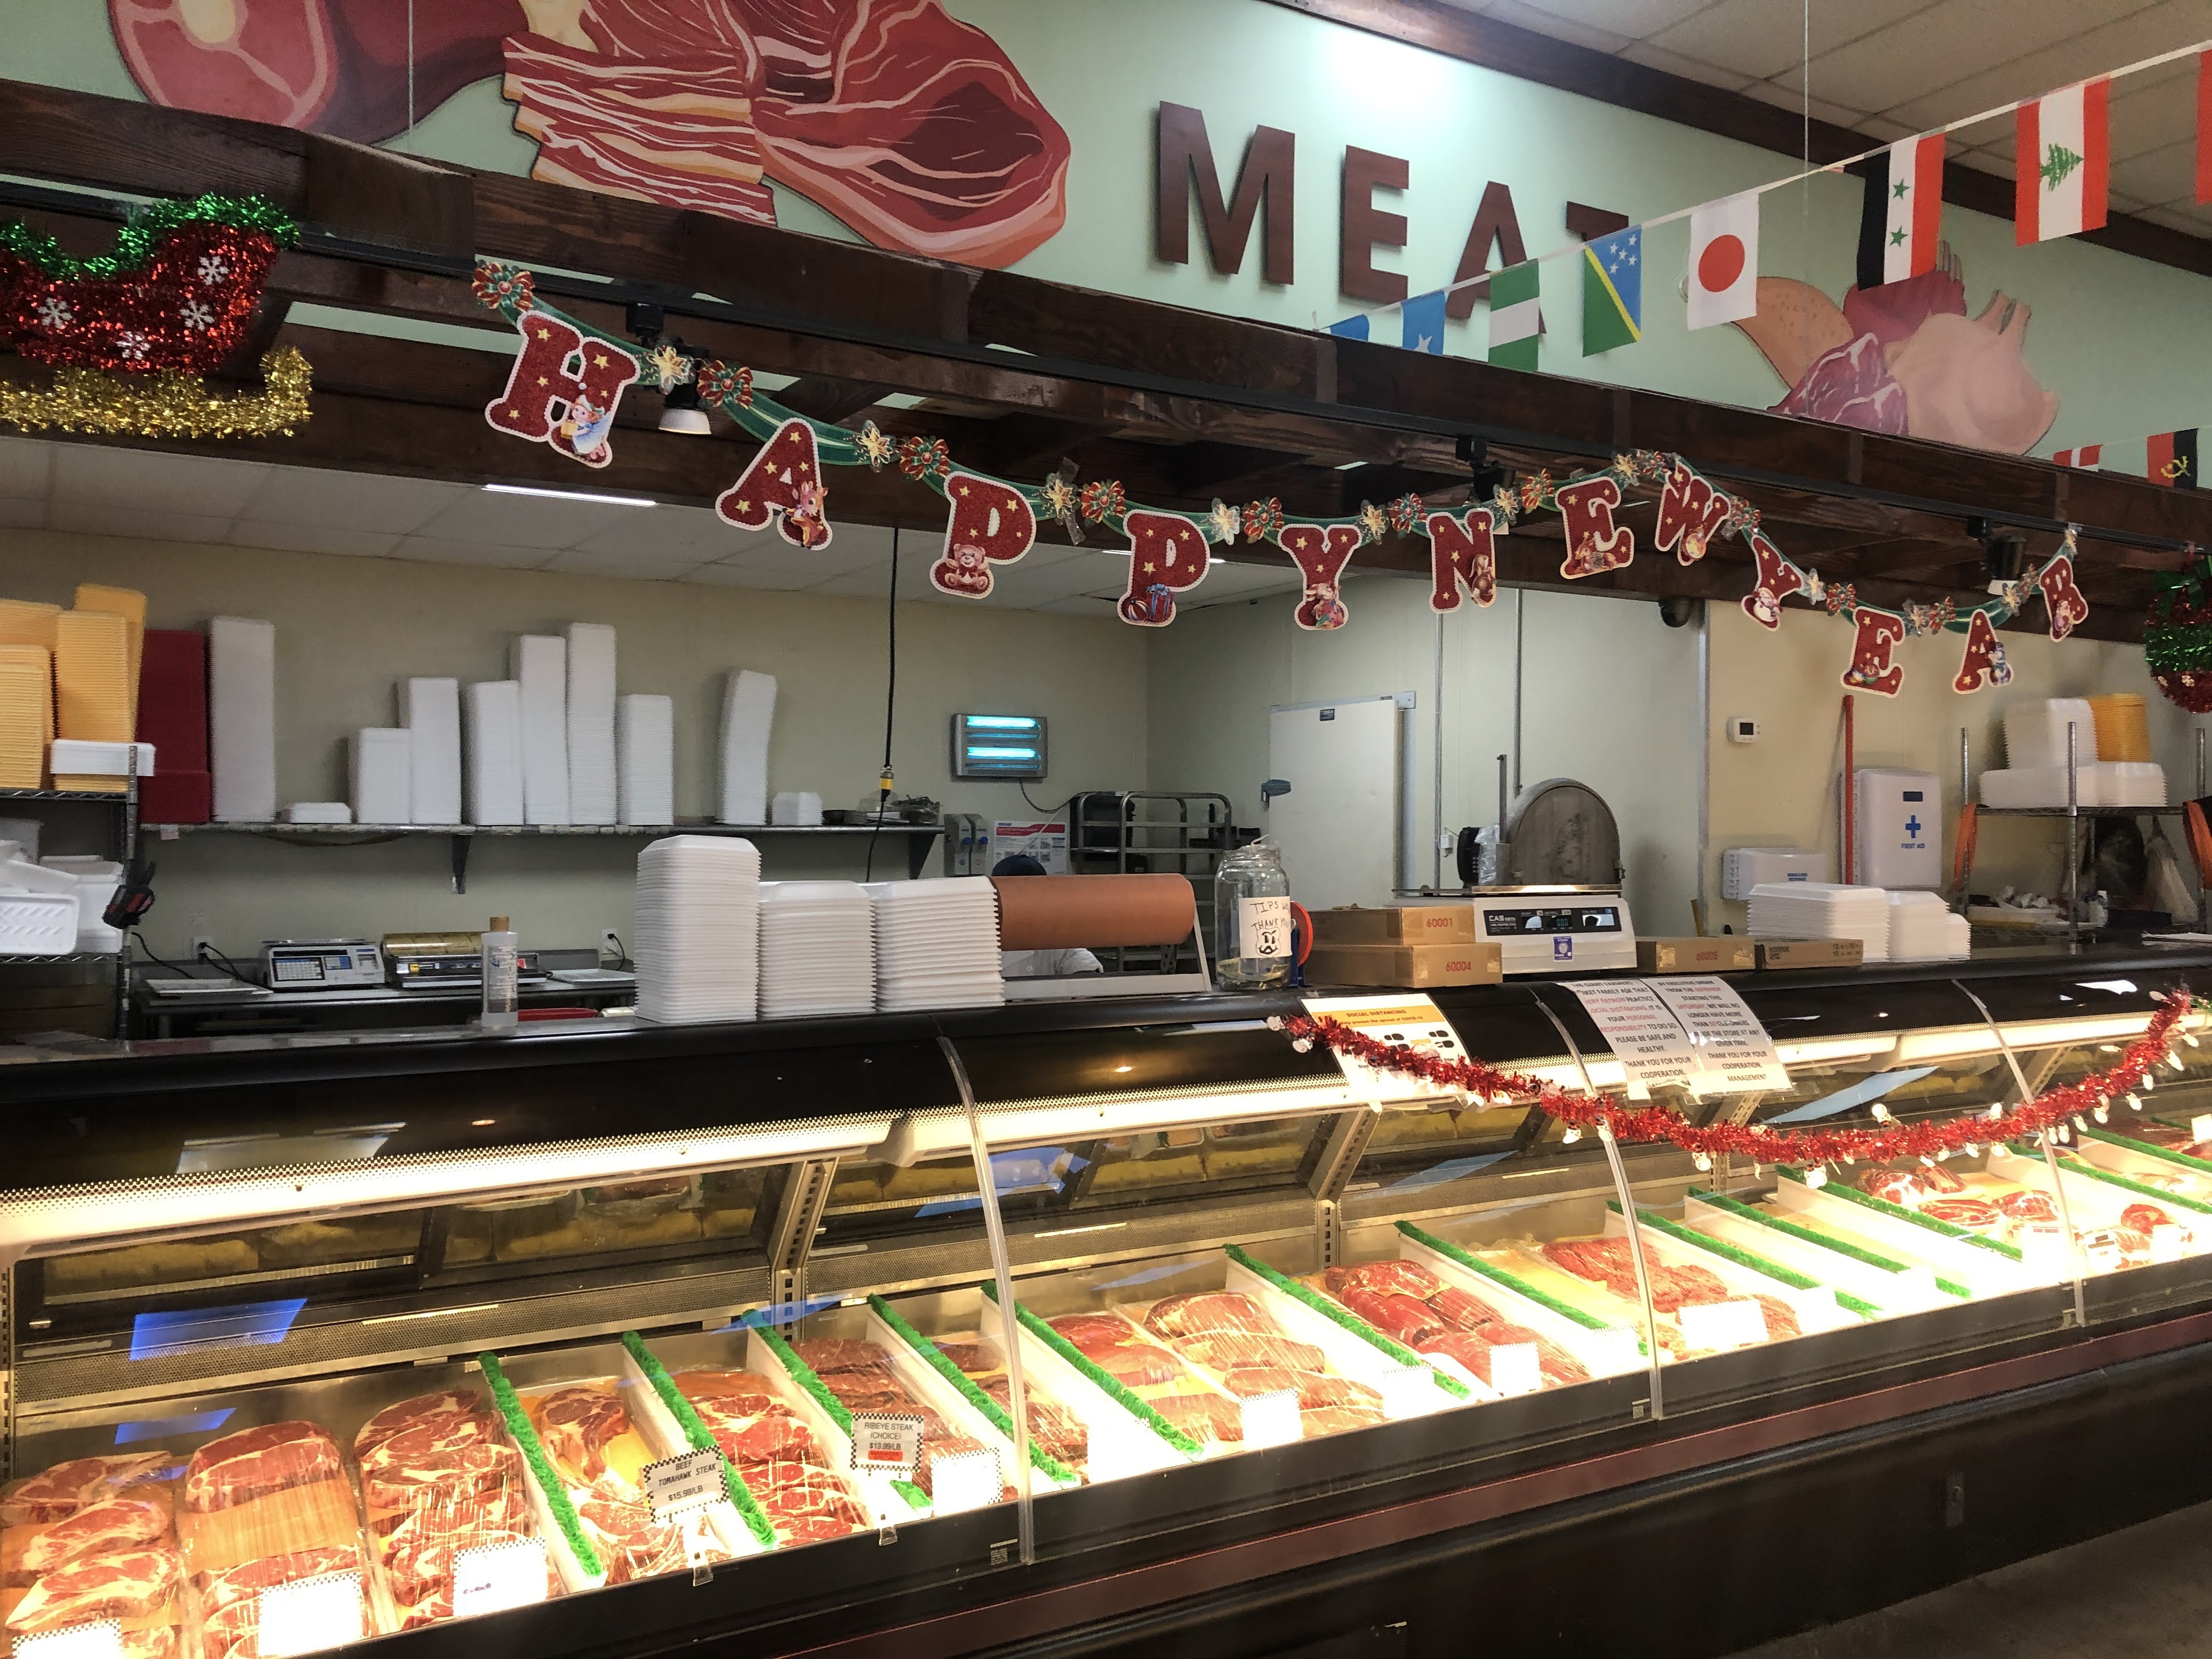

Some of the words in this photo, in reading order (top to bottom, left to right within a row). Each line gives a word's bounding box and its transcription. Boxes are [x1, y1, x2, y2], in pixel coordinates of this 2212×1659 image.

[485, 308, 1362, 631] HAPPY
[1427, 455, 1733, 615] NEW
[1741, 527, 2089, 697] YEAR
[1249, 901, 1278, 915] TIPS
[1251, 917, 1278, 931] THANK
[1426, 918, 1453, 928] 60001
[1446, 961, 1471, 972] 60004
[1599, 1024, 1647, 1032] RESPONSIBILITY
[1637, 1045, 1667, 1053] HEALTHY.
[1727, 1074, 1767, 1082] MANAGEMENT
[864, 1421, 889, 1430] RIBEYE
[870, 1432, 901, 1440] (CHOICE)
[675, 1459, 693, 1471] BEEF
[658, 1470, 692, 1487] TOMAHAWK
[696, 1463, 717, 1476] STEAK
[668, 1485, 704, 1502] $15.99/LB
